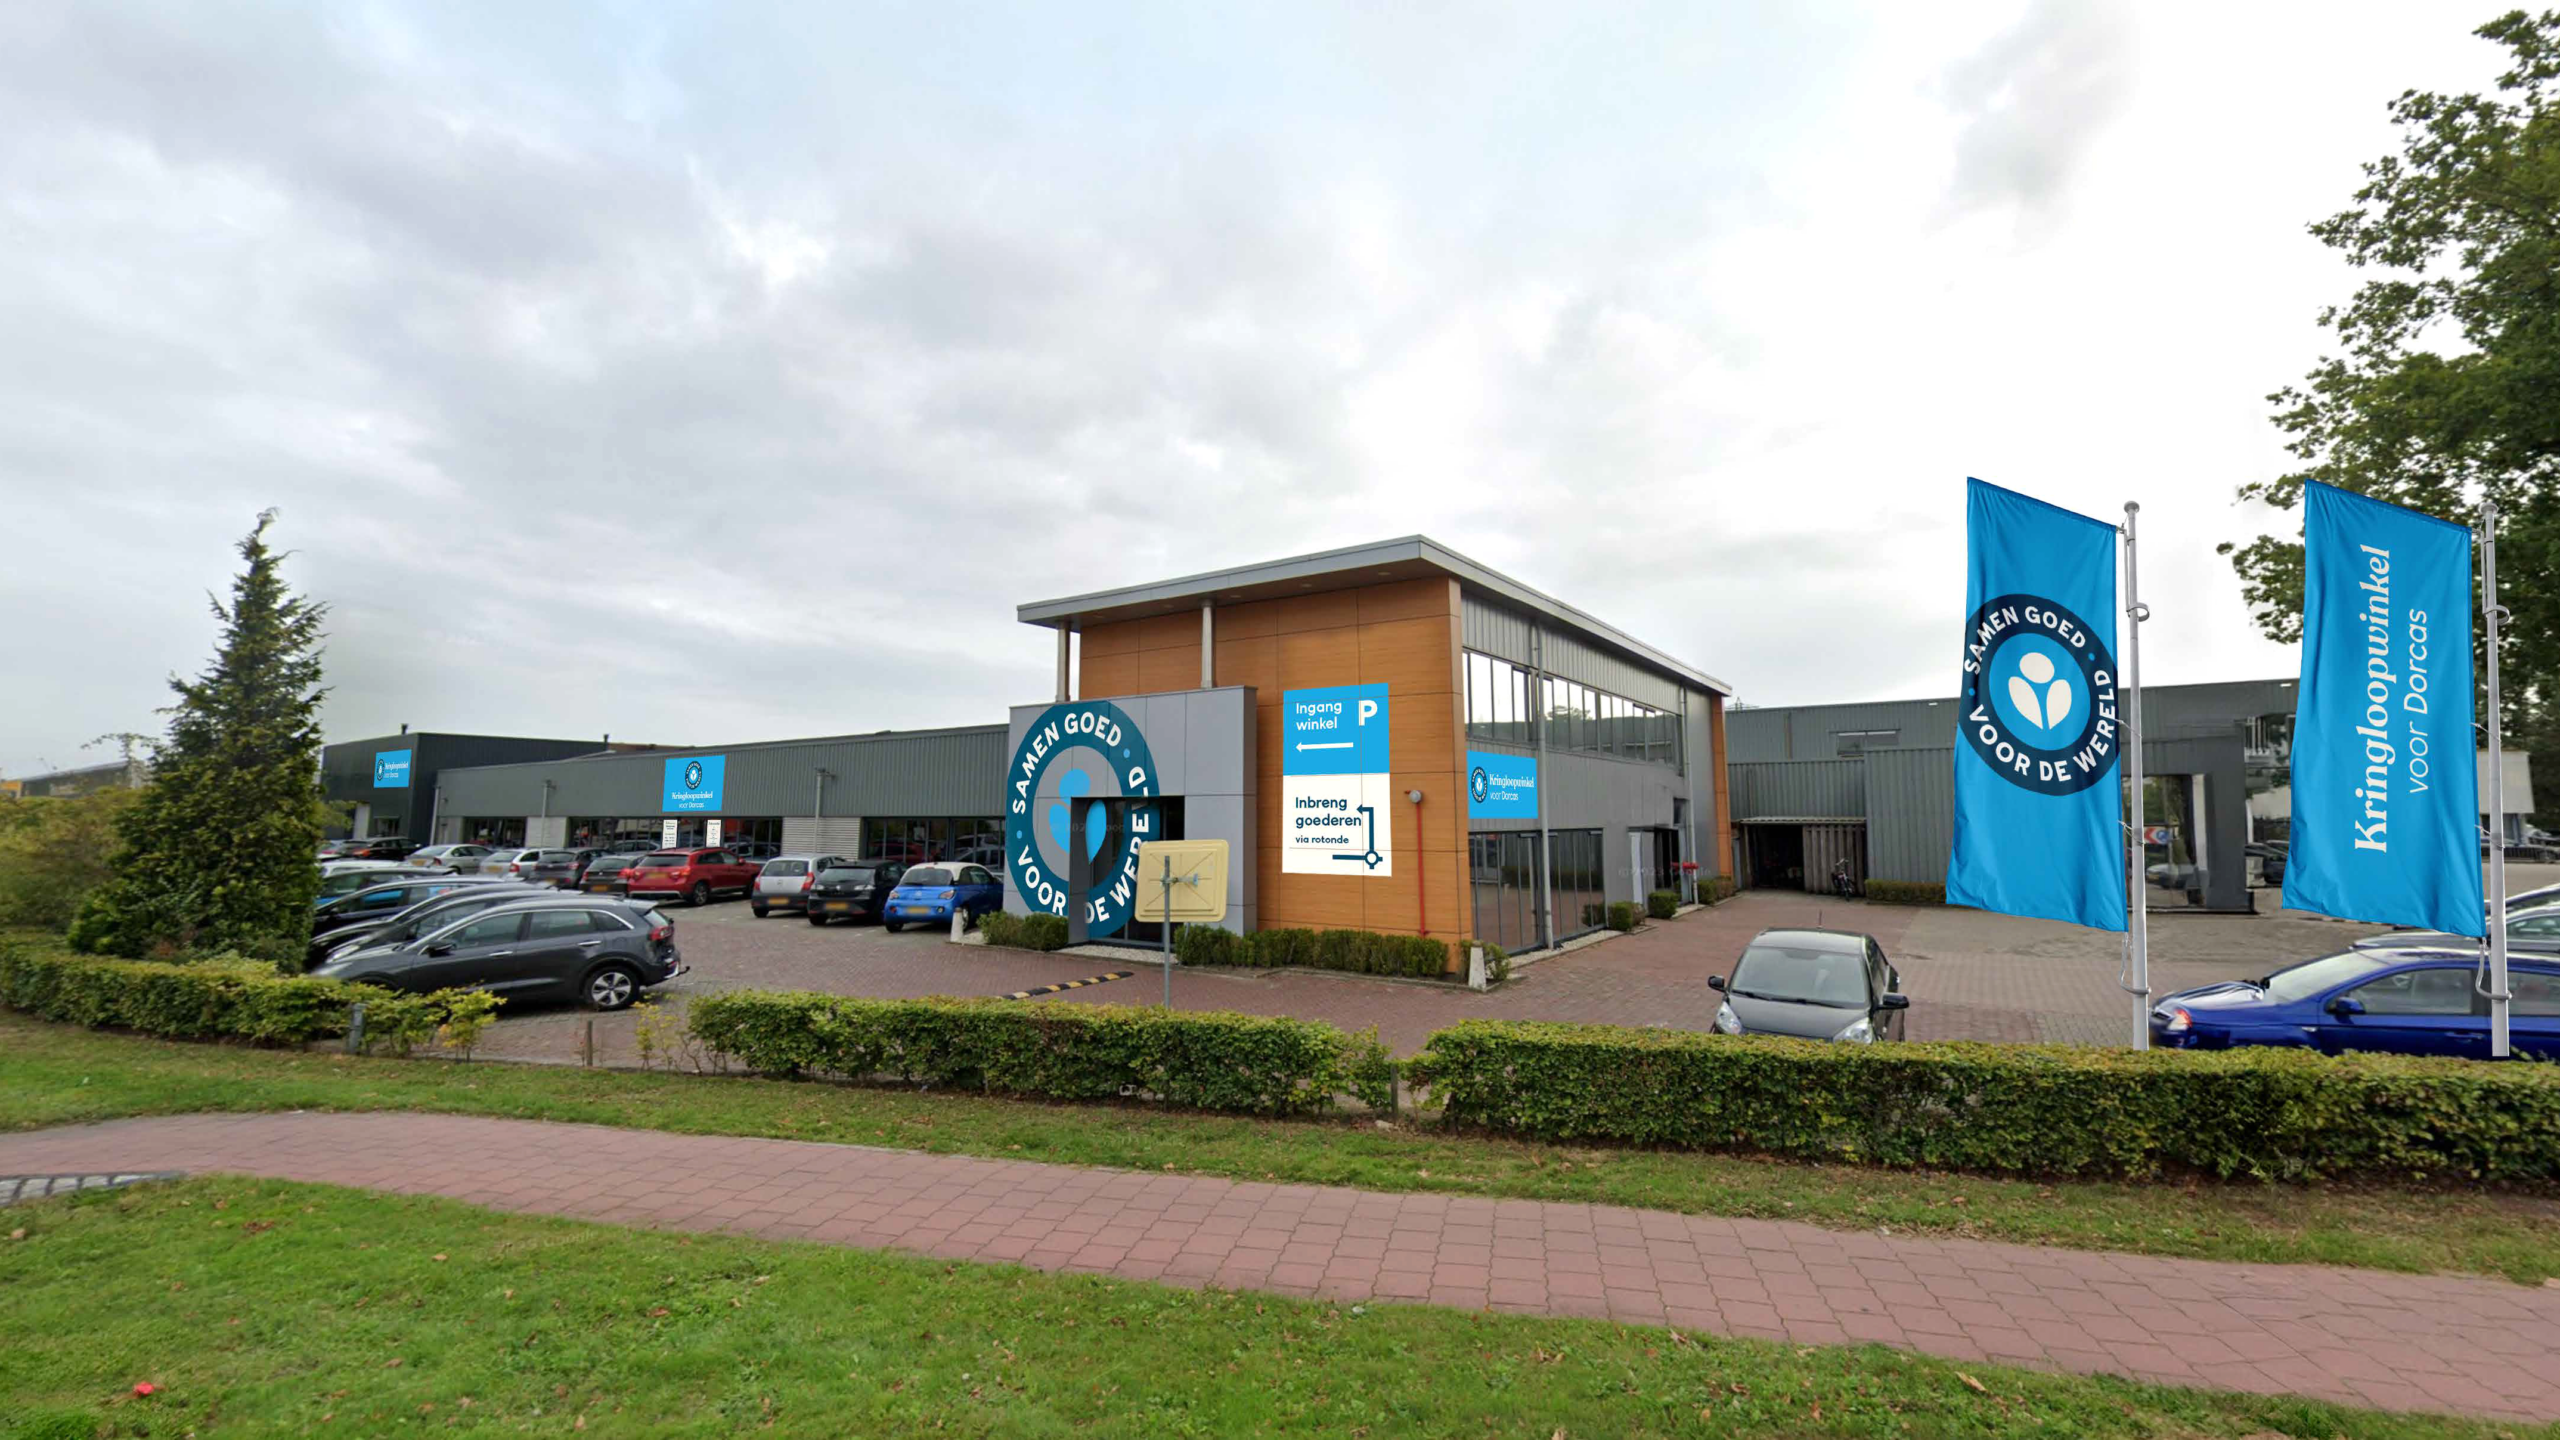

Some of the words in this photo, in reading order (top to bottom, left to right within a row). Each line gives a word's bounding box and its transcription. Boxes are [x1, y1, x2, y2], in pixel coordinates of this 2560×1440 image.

[1964, 606, 2020, 675] SAMEN
[2024, 605, 2086, 649] GOED
[2403, 608, 2428, 714] Dorcas
[1296, 702, 1342, 716] Ingang
[2354, 544, 2397, 853] Kringloopwinkel
[1358, 700, 1378, 726] P
[1296, 717, 1338, 731] winkel
[1969, 704, 2031, 776] VOOR
[2039, 760, 2072, 782] DE
[2073, 670, 2115, 773] WERELD
[1012, 721, 1060, 815] SAMEN
[1064, 711, 1122, 747] GOED
[2409, 721, 2429, 794] voor
[1489, 773, 1535, 790] Kringloopwinkel
[671, 791, 713, 801] Kringloopwinkel
[1295, 796, 1348, 811] Inbreng
[1490, 792, 1501, 800] voor
[1502, 791, 1519, 801] Dorcas
[1295, 813, 1362, 829] goederen
[1295, 835, 1309, 844] via
[1311, 835, 1349, 844] rotonde
[1017, 844, 1067, 916] VOOR
[1085, 896, 1110, 924] DE
